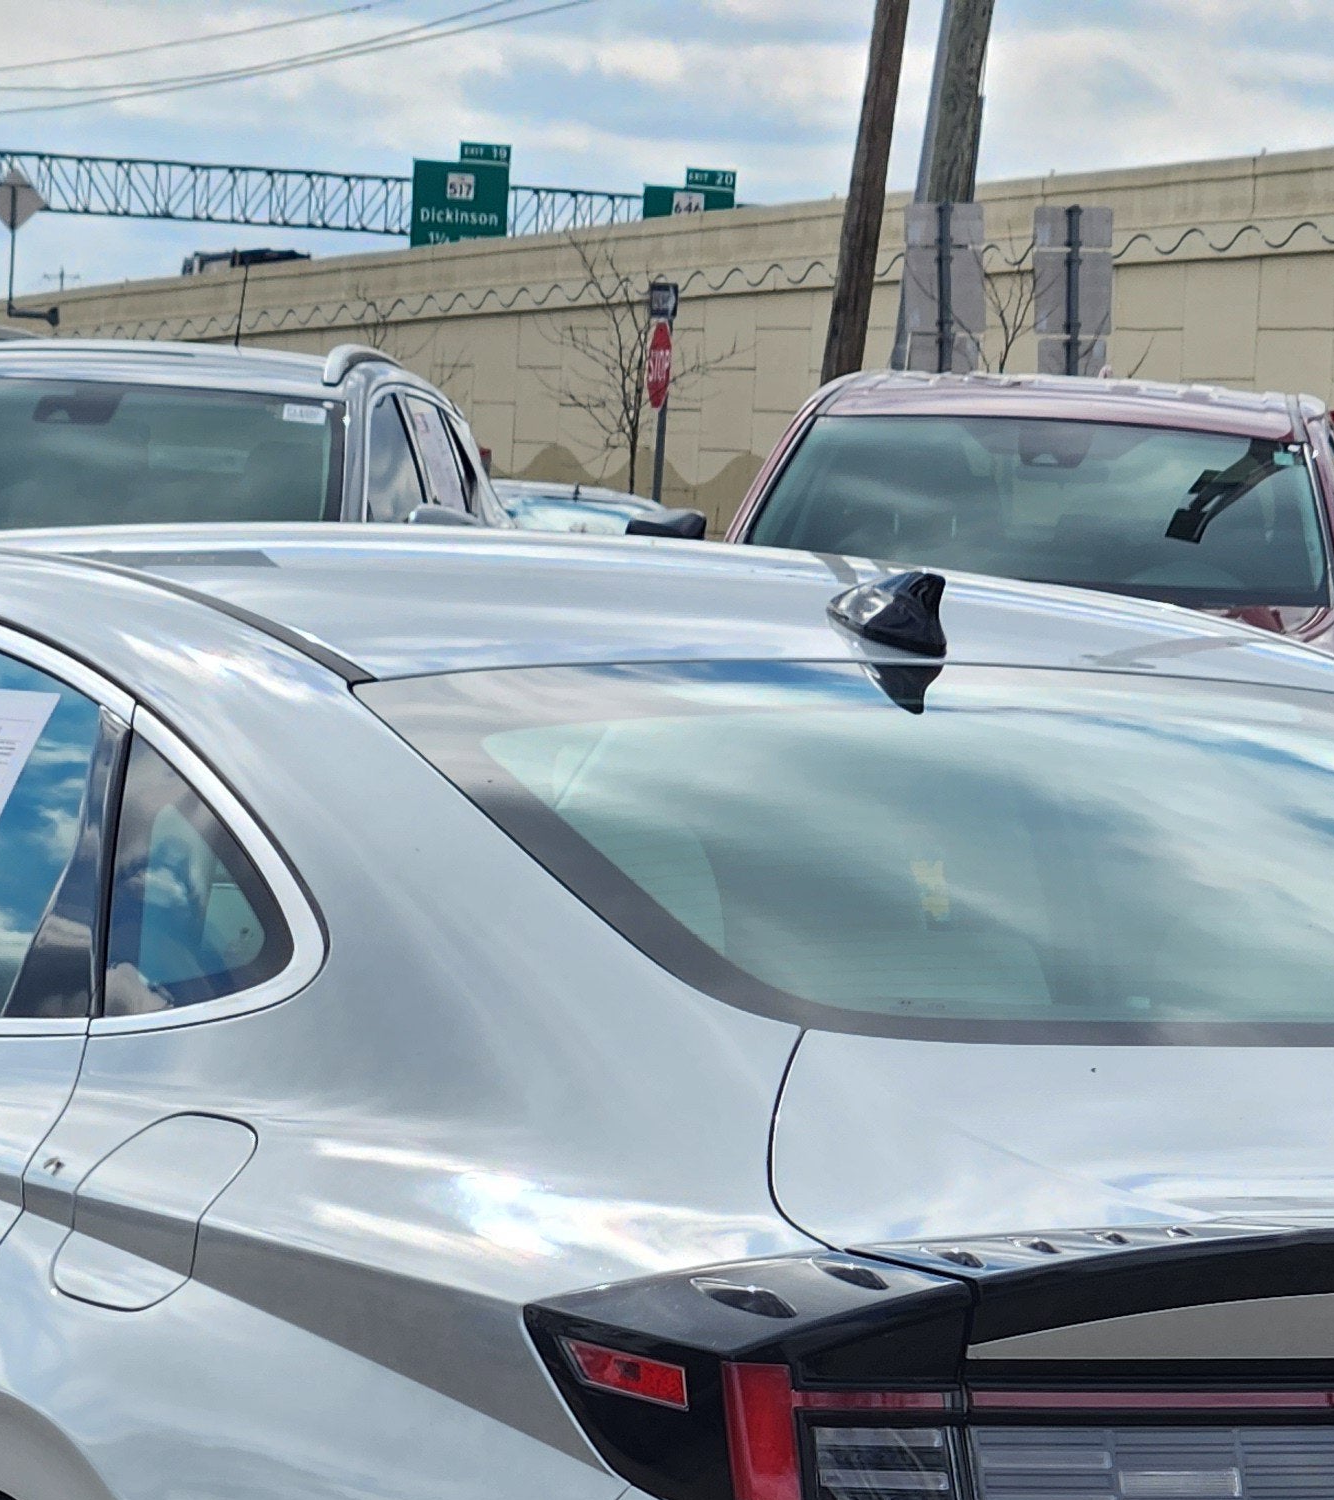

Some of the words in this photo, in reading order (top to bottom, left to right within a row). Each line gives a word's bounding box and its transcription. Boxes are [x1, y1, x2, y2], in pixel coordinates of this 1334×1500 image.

[463, 146, 484, 157] EXIT
[688, 171, 709, 182] EXIT
[449, 181, 472, 197] 517
[420, 205, 499, 227] Dickinson
[648, 348, 671, 383] STOP
